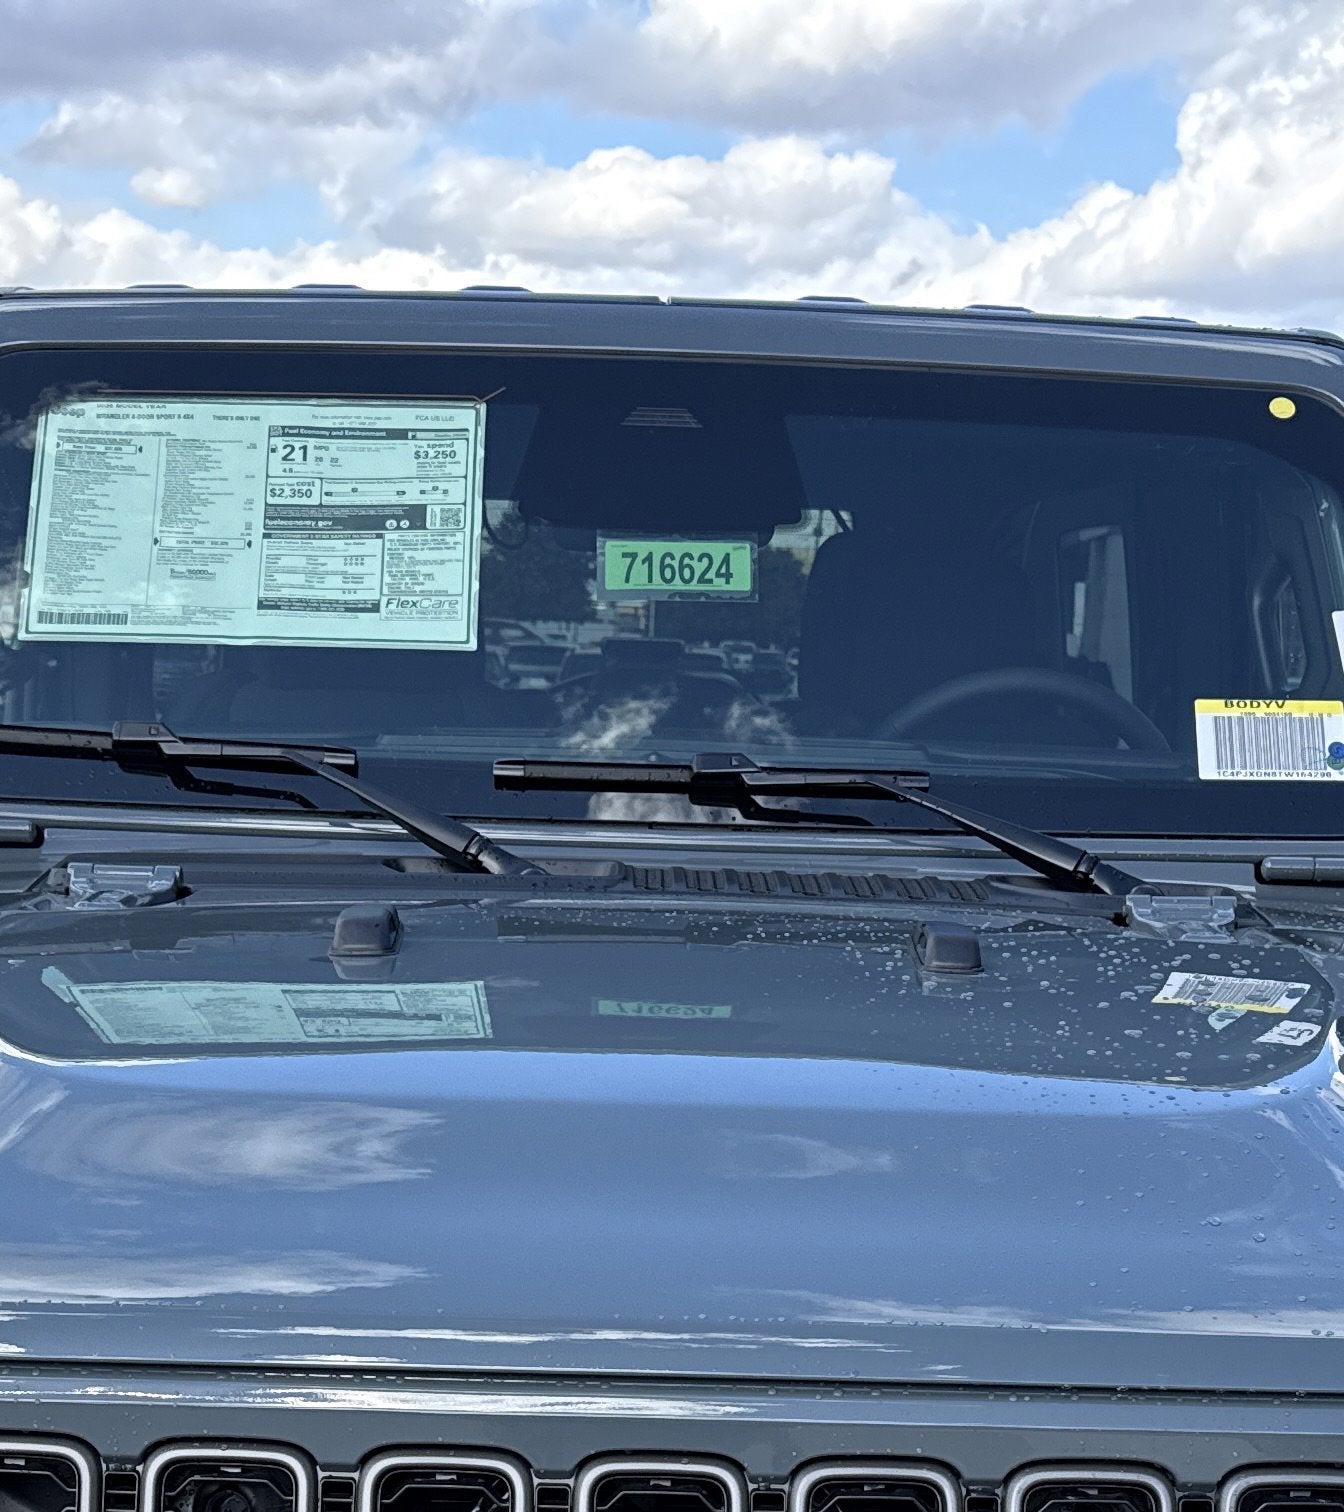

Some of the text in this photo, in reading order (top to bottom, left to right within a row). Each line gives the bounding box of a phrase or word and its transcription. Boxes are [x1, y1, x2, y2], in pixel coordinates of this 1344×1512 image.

[427, 441, 455, 450] spend
[281, 443, 308, 462] 21
[413, 449, 457, 461] $3,250
[269, 488, 313, 500] $2,350
[621, 551, 734, 585] 716624
[385, 597, 459, 609] FlexCare
